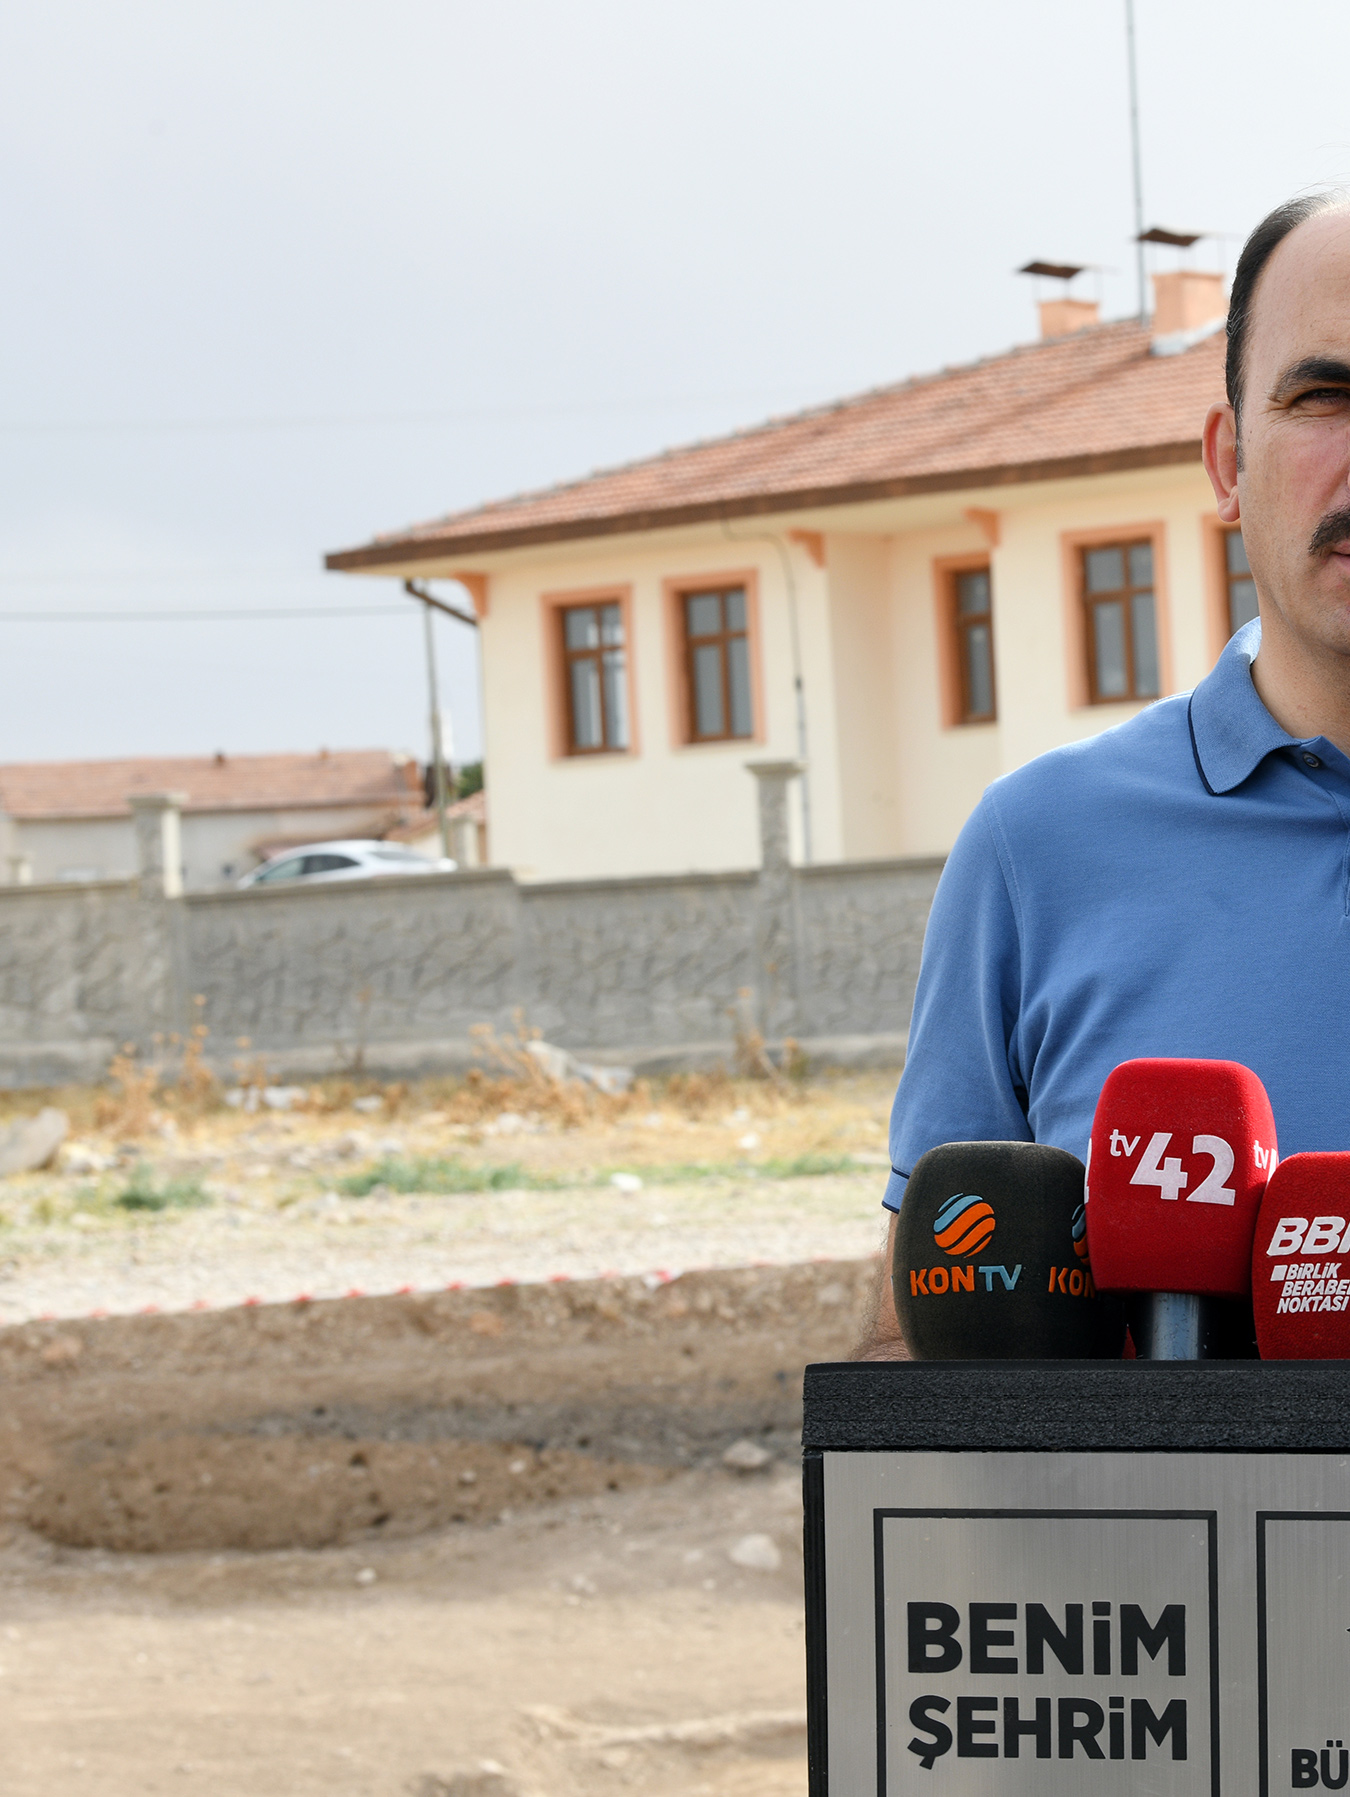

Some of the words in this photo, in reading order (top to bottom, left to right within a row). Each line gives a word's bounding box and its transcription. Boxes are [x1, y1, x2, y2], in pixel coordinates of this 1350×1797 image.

[1109, 1128, 1141, 1158] tv
[1129, 1132, 1236, 1206] 42
[1276, 1295, 1350, 1314] NOKTASI
